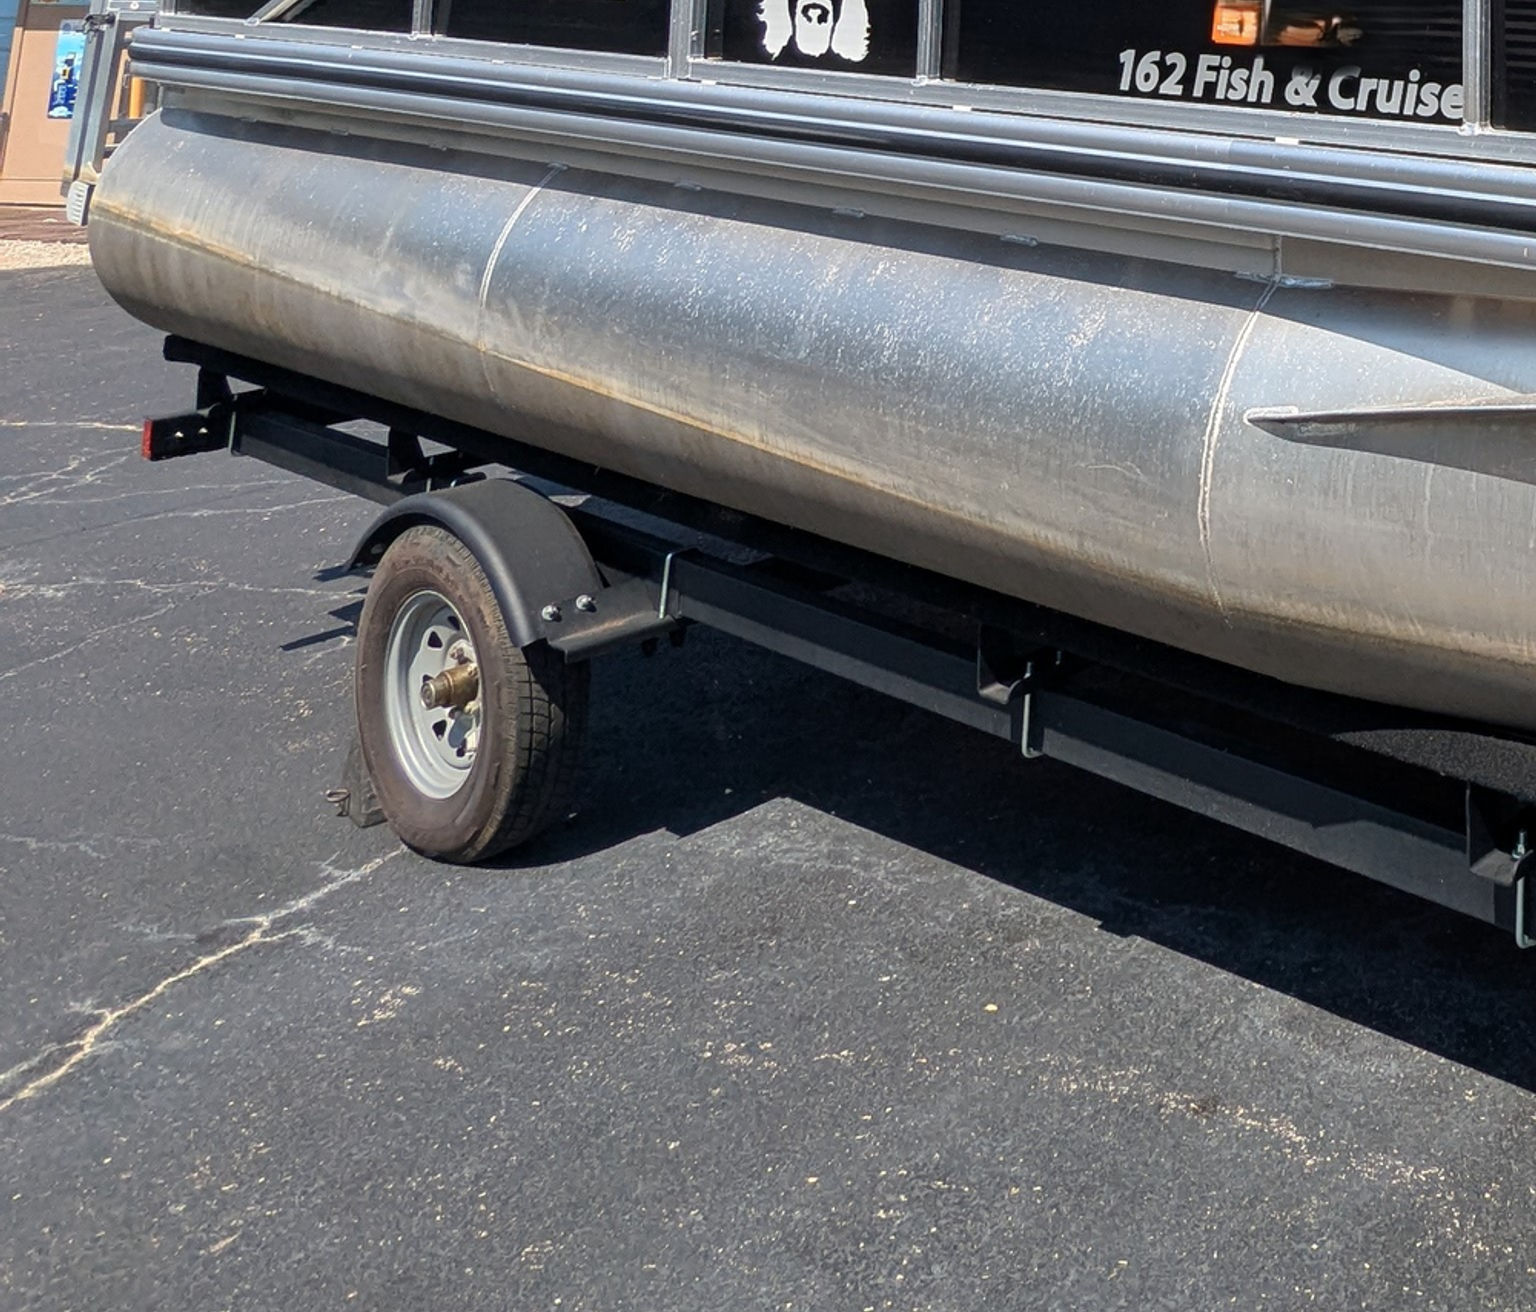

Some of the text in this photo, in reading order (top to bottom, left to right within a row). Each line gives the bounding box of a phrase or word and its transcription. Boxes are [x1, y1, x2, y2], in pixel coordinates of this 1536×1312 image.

[1118, 49, 1464, 120] 162 Fish & Cruise
